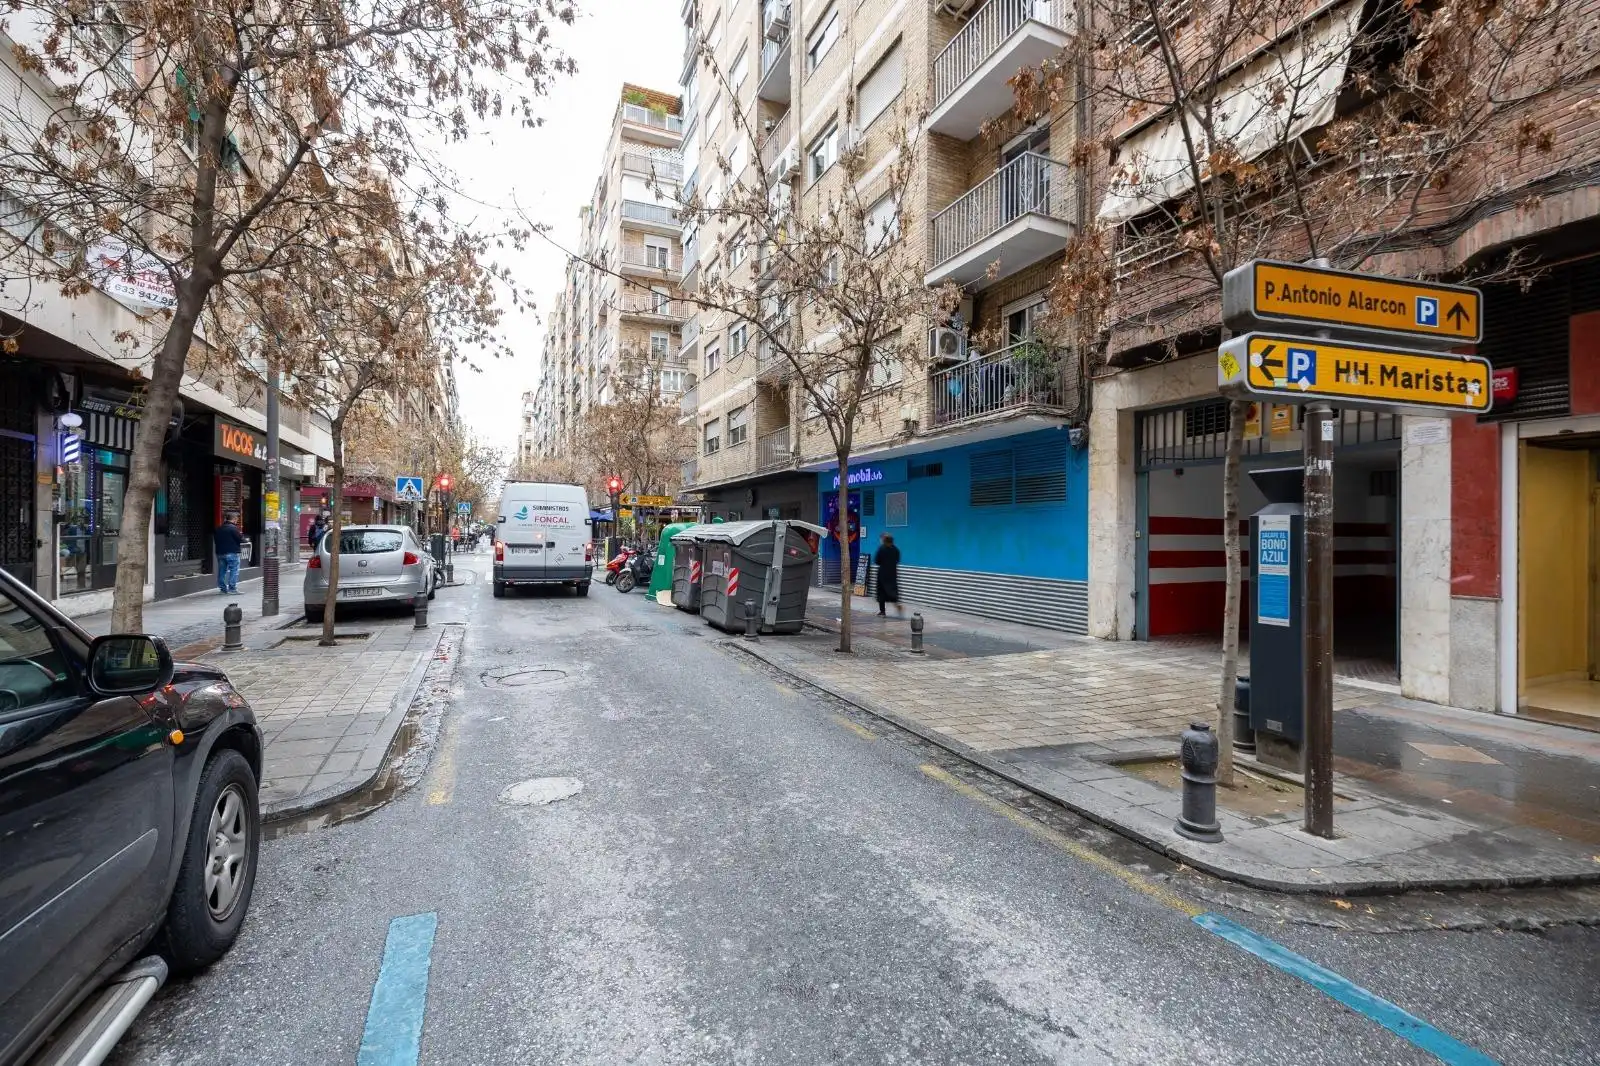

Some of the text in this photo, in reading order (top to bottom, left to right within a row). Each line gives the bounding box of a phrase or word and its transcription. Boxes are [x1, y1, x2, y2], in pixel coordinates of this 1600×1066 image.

[114, 284, 135, 295] 633
[1264, 281, 1435, 322] P.Antonio Alarcon P
[1291, 351, 1482, 396] P HH. Maristas
[221, 423, 254, 456] TACOS
[833, 468, 870, 488] plmobil
[534, 515, 569, 524] FONCAL
[1261, 539, 1286, 550] BONO
[1261, 551, 1287, 563] AZUL
